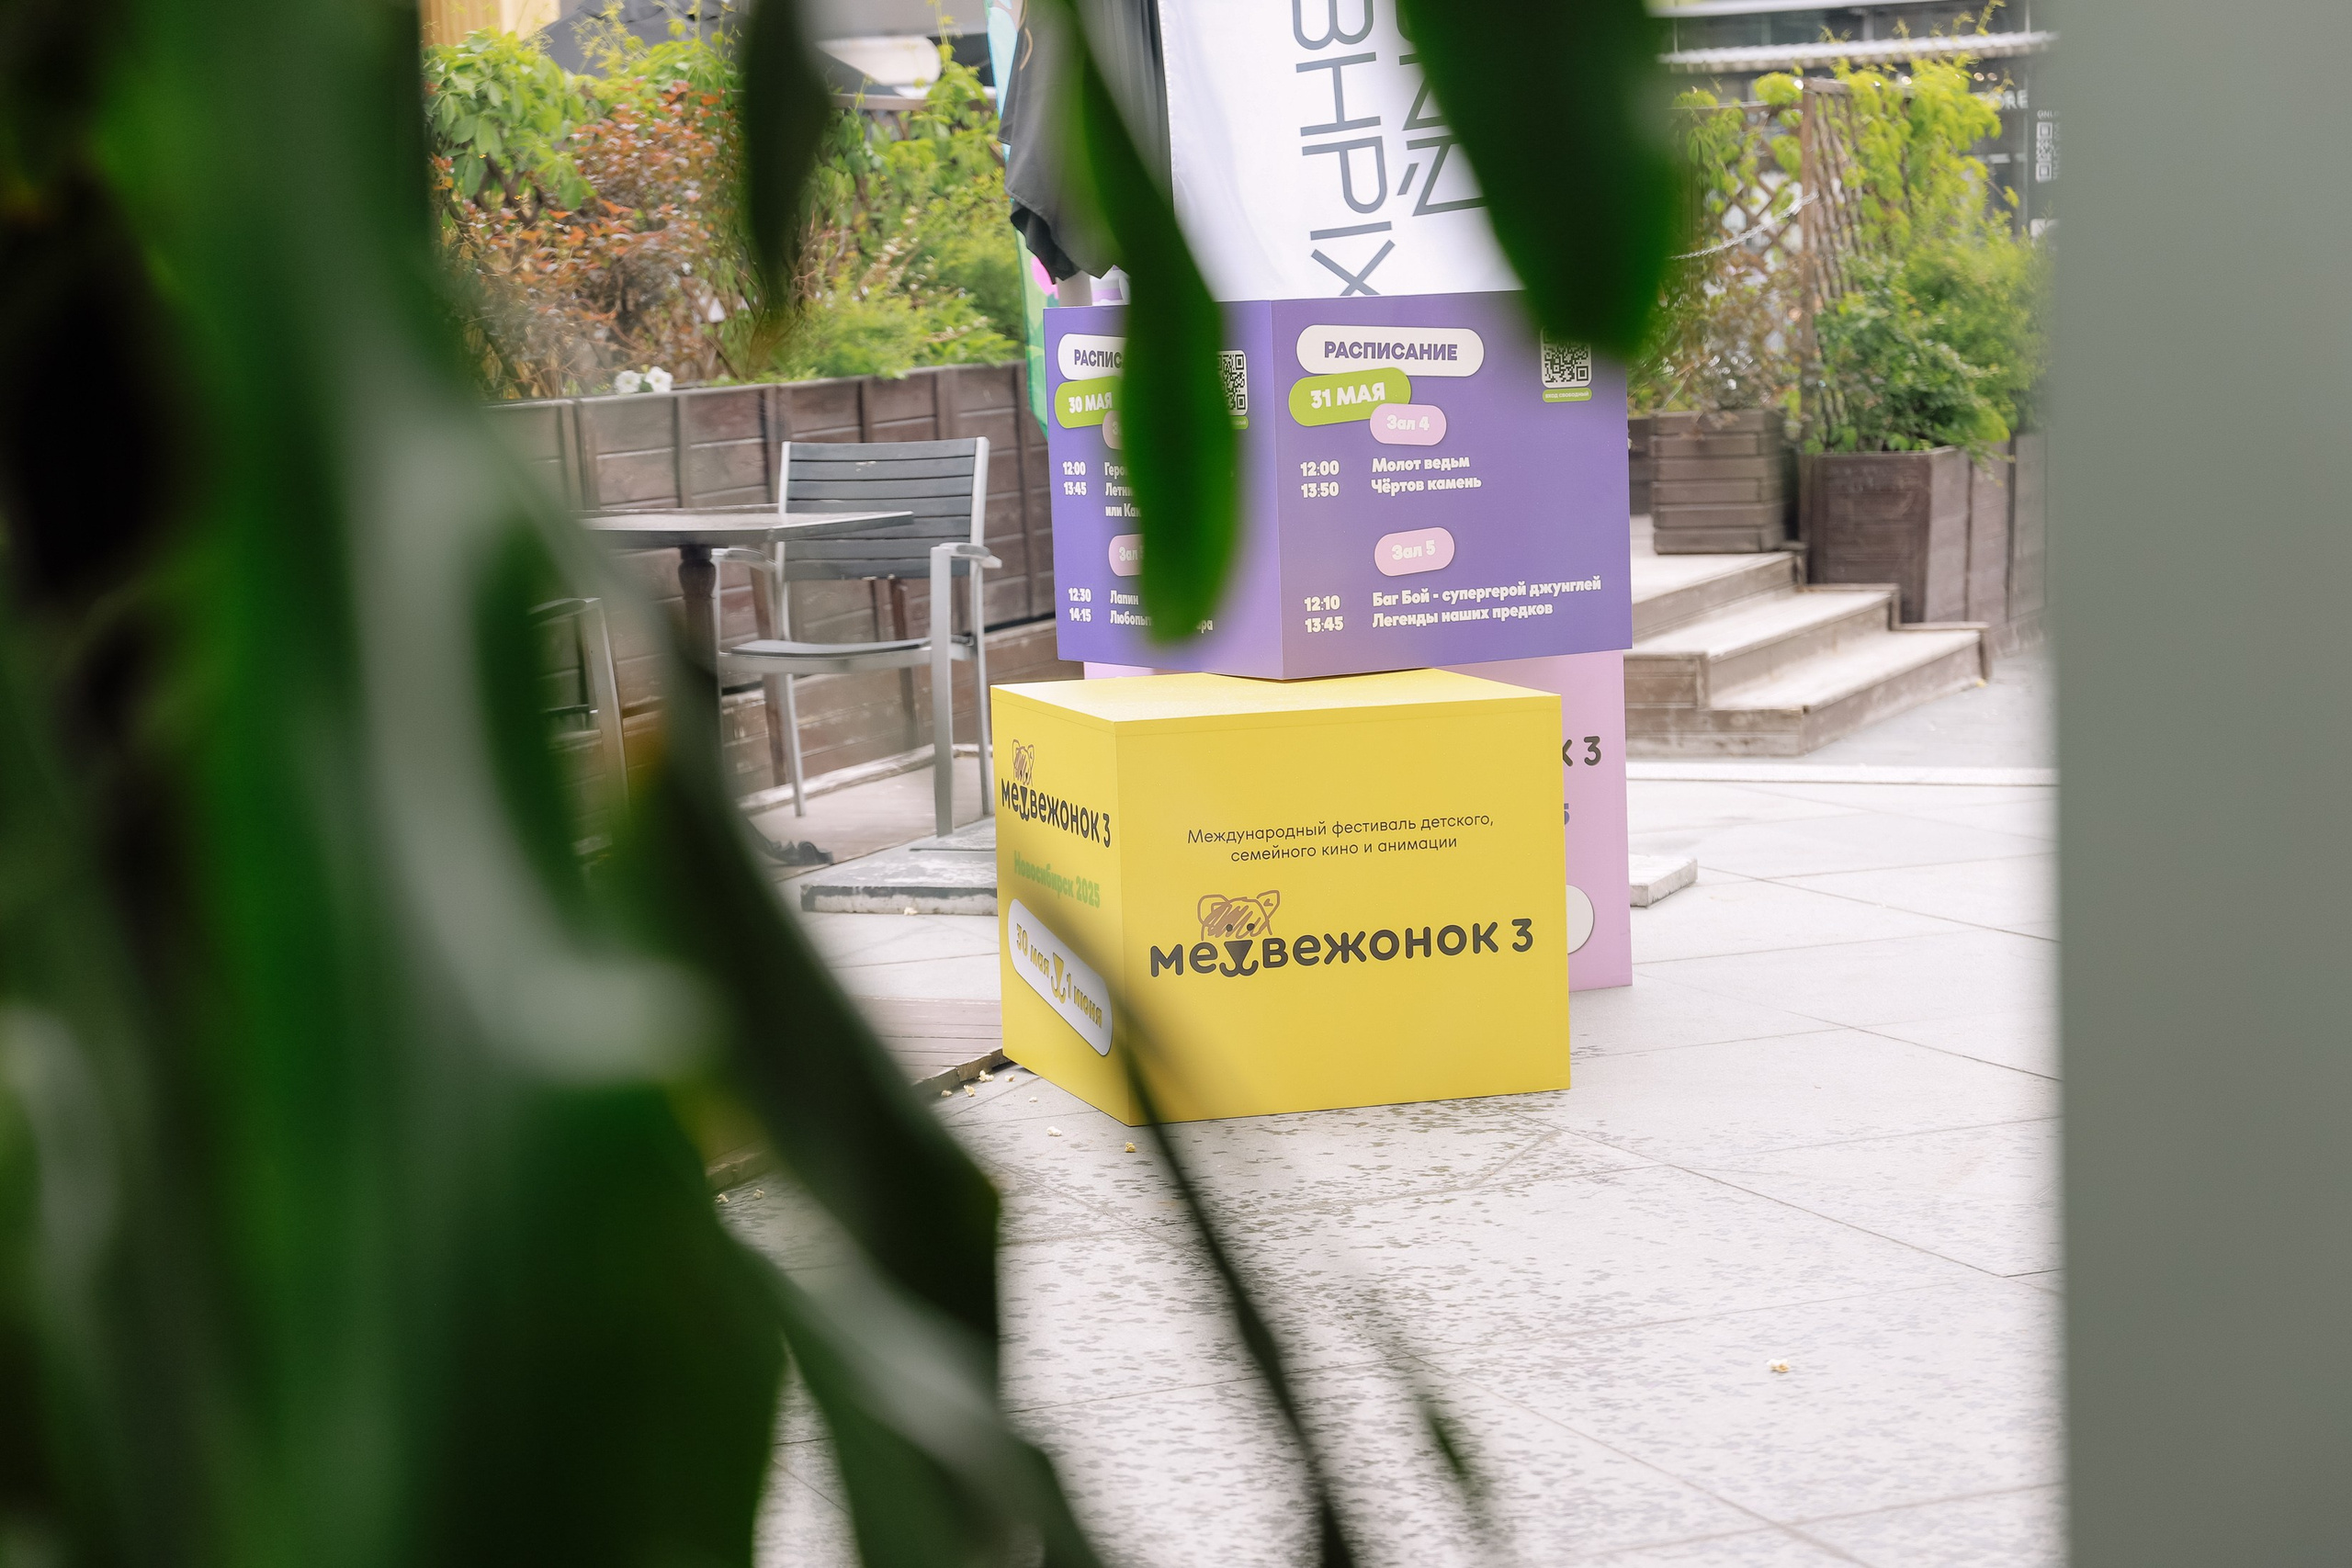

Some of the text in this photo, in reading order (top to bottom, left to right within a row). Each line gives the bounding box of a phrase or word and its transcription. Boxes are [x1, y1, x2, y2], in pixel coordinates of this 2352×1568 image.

[1073, 348, 1123, 368] РАСПИС
[1324, 341, 1459, 361] РАСПИСАНИЕ
[1068, 391, 1114, 413] 30 МАЯ
[1310, 382, 1385, 410] 31 МАЯ
[1386, 414, 1430, 432] Зал 4
[1063, 461, 1086, 476] 12:00
[1300, 460, 1340, 477] 12:00
[1372, 456, 1470, 474] Молот ведьм
[1063, 481, 1087, 496] 13:45
[1104, 481, 1134, 497] Летни
[1301, 481, 1340, 498] 13:50
[1371, 476, 1482, 497] Чёртов камень
[1105, 505, 1123, 517] или
[1118, 546, 1139, 561] Зал
[1392, 540, 1436, 561] Зал 5
[1069, 588, 1091, 603] 12:30
[1110, 590, 1139, 605] Лапин
[1373, 591, 1398, 607] Баг
[1401, 586, 1430, 604] Бой
[1442, 581, 1527, 604] супергерой
[1529, 574, 1601, 598] джунглей
[1304, 595, 1340, 612] 12:10
[1069, 607, 1091, 622] 14:15
[1110, 610, 1152, 627] Любопыт
[1305, 615, 1344, 633] 13:45
[1372, 602, 1554, 628] Легенды наших предков
[1584, 736, 1601, 766] 3
[1102, 812, 1111, 848] 3
[1187, 812, 1494, 845] Международный фестиваль детского,
[1230, 836, 1457, 863] семейного кино и анимации
[1013, 850, 1101, 908] Новосибирск 2025
[1511, 918, 1534, 953] 3
[1016, 922, 1102, 1029] 30 мая 1 июня
